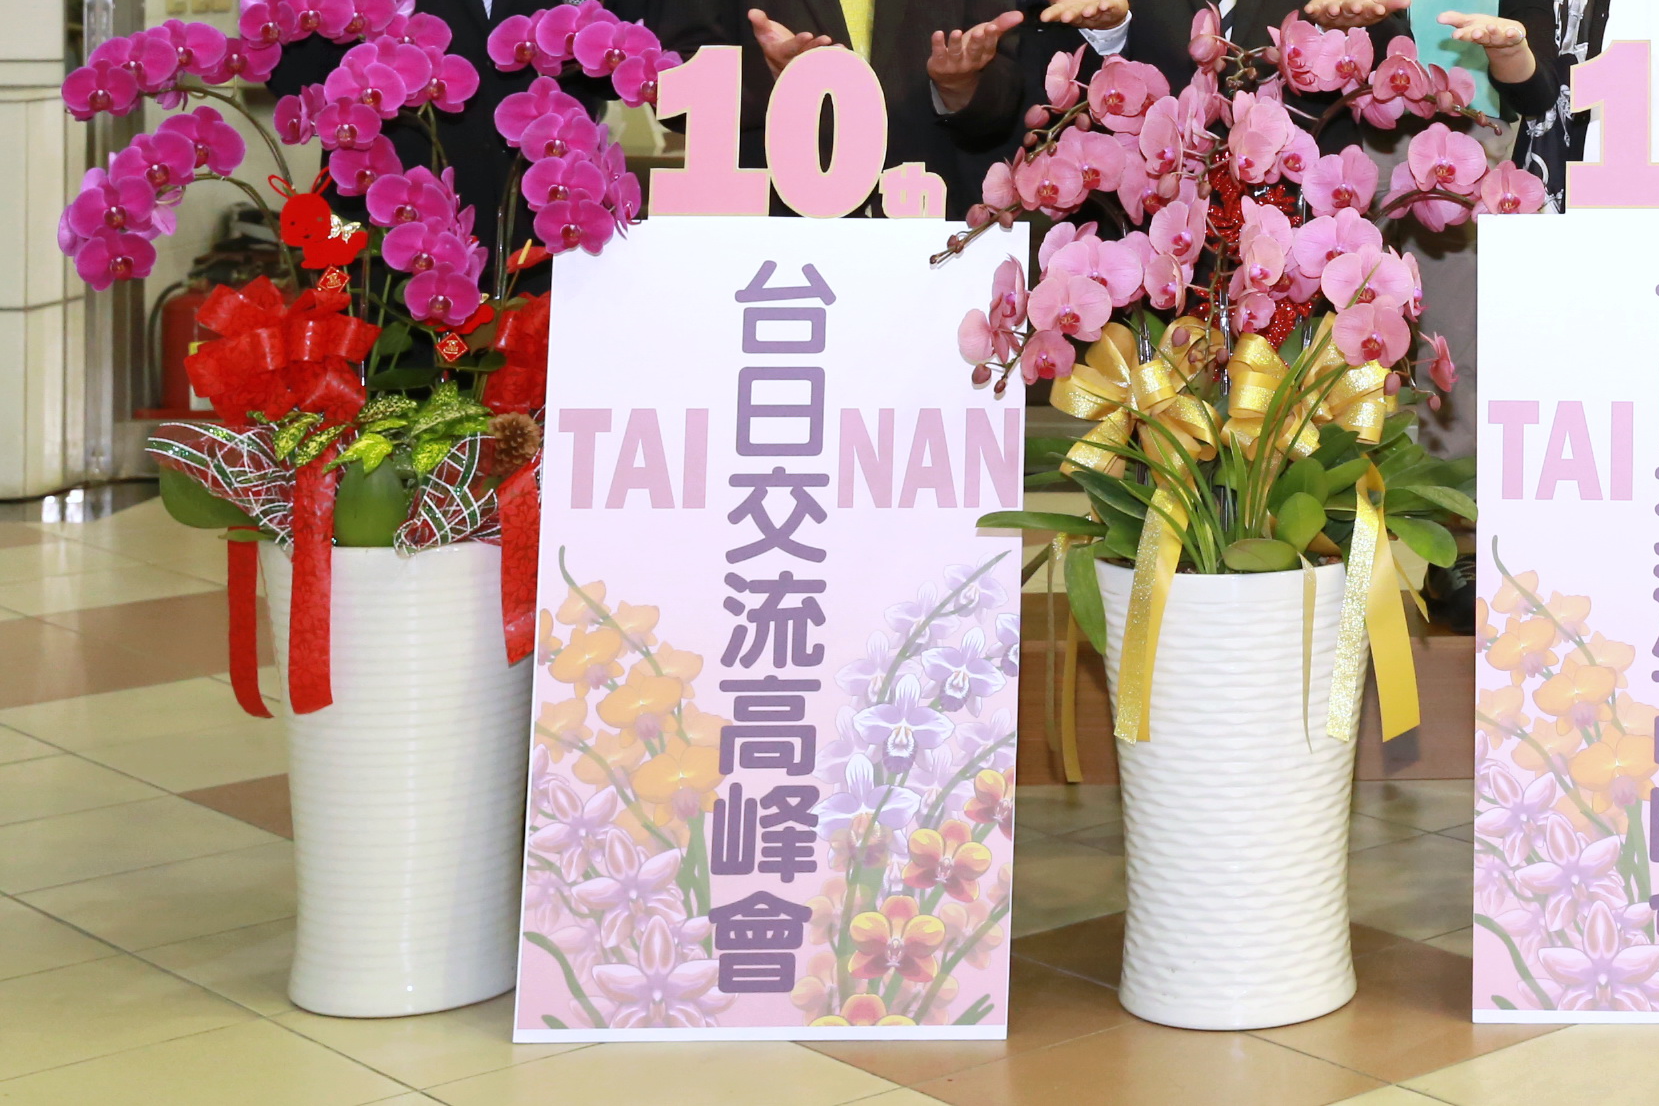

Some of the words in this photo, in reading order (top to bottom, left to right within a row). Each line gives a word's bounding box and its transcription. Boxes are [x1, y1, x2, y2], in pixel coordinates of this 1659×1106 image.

[558, 408, 709, 509] TAI
[837, 408, 1020, 509] NAN
[1487, 400, 1634, 501] TAI
[708, 260, 836, 993] 台日交流高峰會
